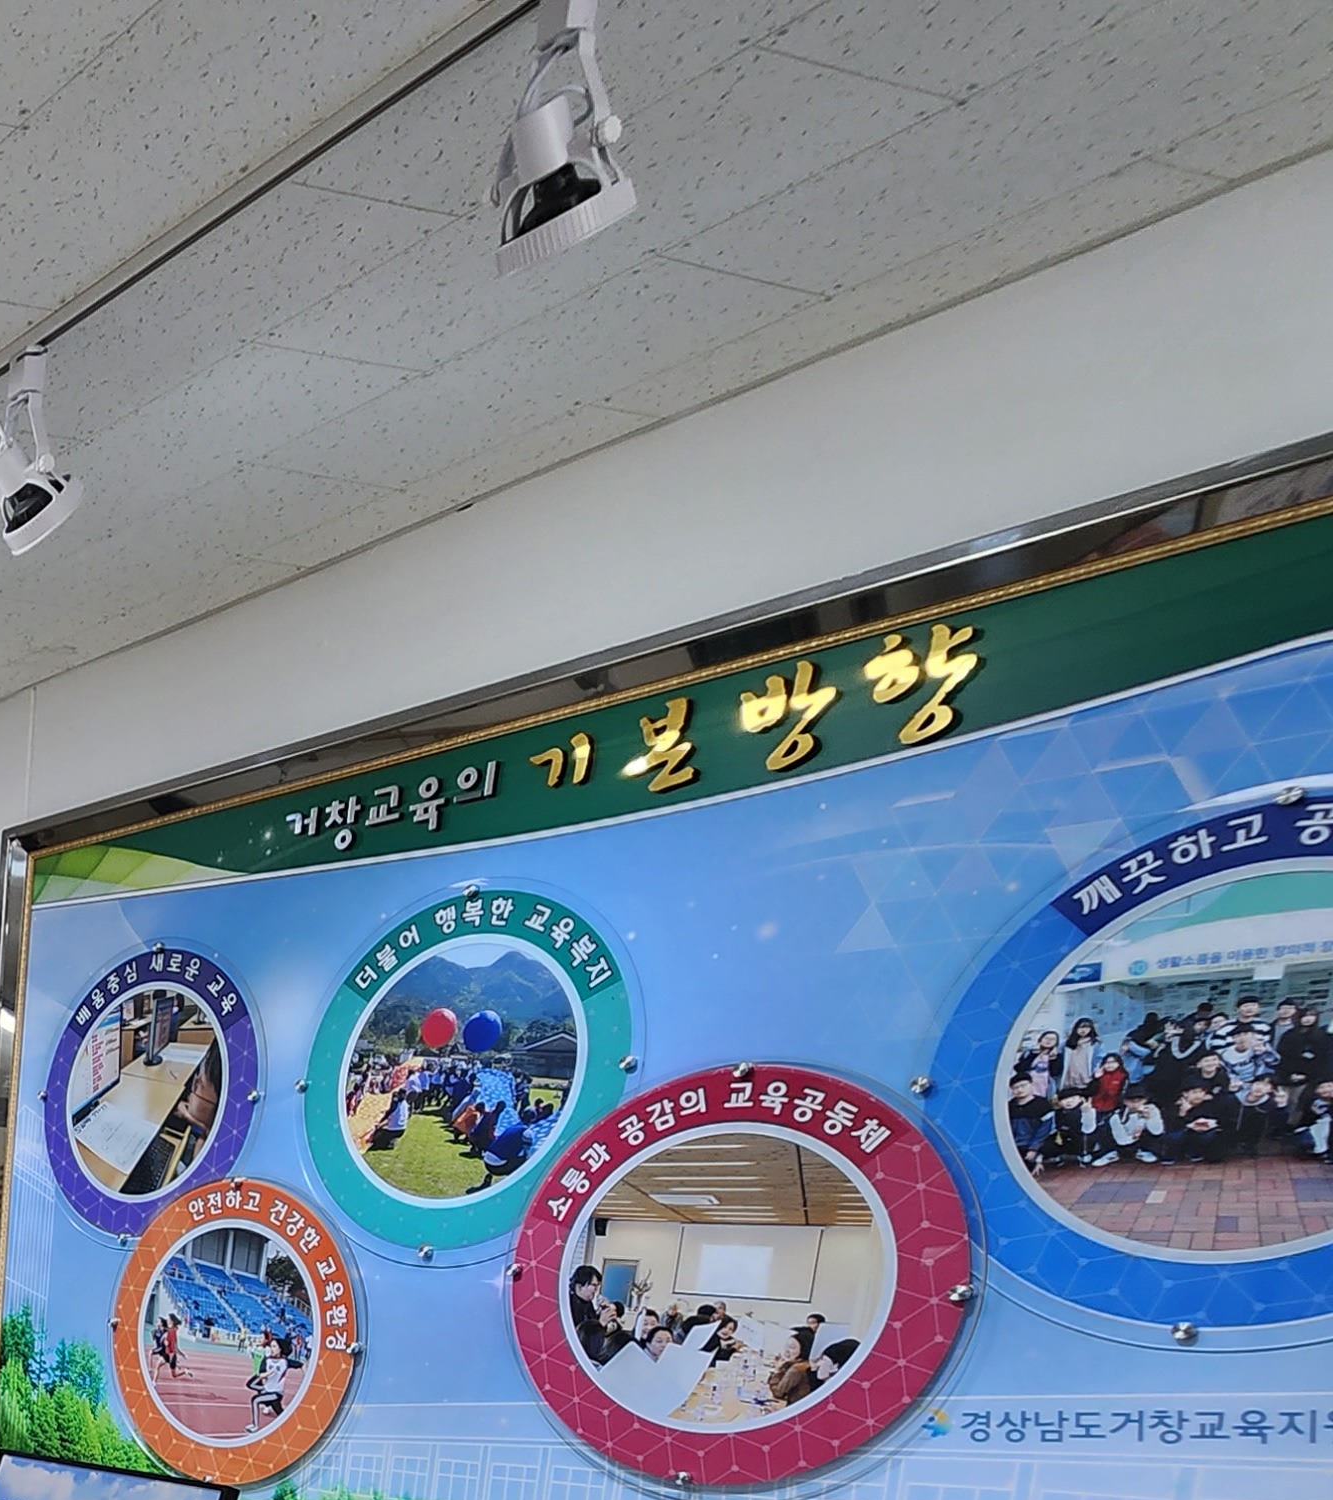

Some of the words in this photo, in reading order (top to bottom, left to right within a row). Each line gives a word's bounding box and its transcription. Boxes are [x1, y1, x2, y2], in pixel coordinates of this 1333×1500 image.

[284, 759, 498, 851] 거창교육의
[1071, 813, 1269, 915] 깨끗하고
[75, 961, 138, 1026] 배움중심
[149, 953, 201, 982] 새로운
[206, 974, 237, 1016] 교육
[354, 924, 422, 990] 더불어
[434, 896, 515, 934] 행복한
[524, 904, 613, 989] 교육복지
[545, 1141, 612, 1222] 소통과
[617, 1087, 708, 1147] 공감의
[723, 1080, 894, 1155] 교육공동체
[188, 1190, 261, 1221] 안전하고
[269, 1199, 321, 1254] 건강한
[316, 1256, 348, 1350] 교육환경
[961, 1408, 1333, 1445] 경상남도거창교육지
